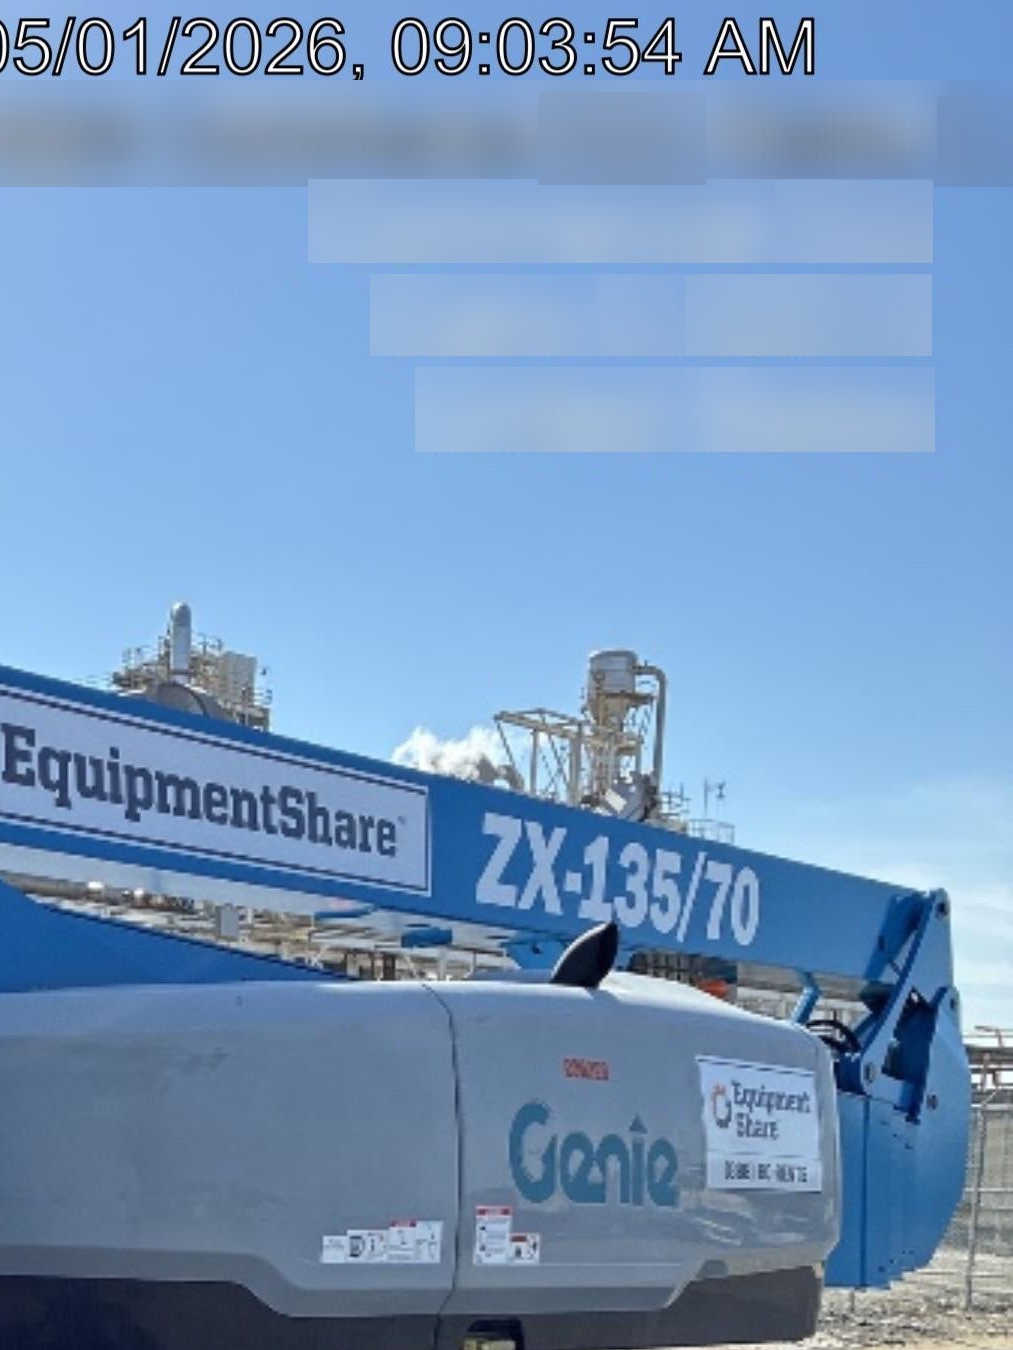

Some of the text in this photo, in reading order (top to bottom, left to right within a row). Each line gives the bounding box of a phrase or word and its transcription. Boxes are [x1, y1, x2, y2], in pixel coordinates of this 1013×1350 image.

[0, 722, 396, 857] EquipmentShare
[476, 812, 759, 945] ZX-135/70
[509, 1099, 679, 1206] Genie
